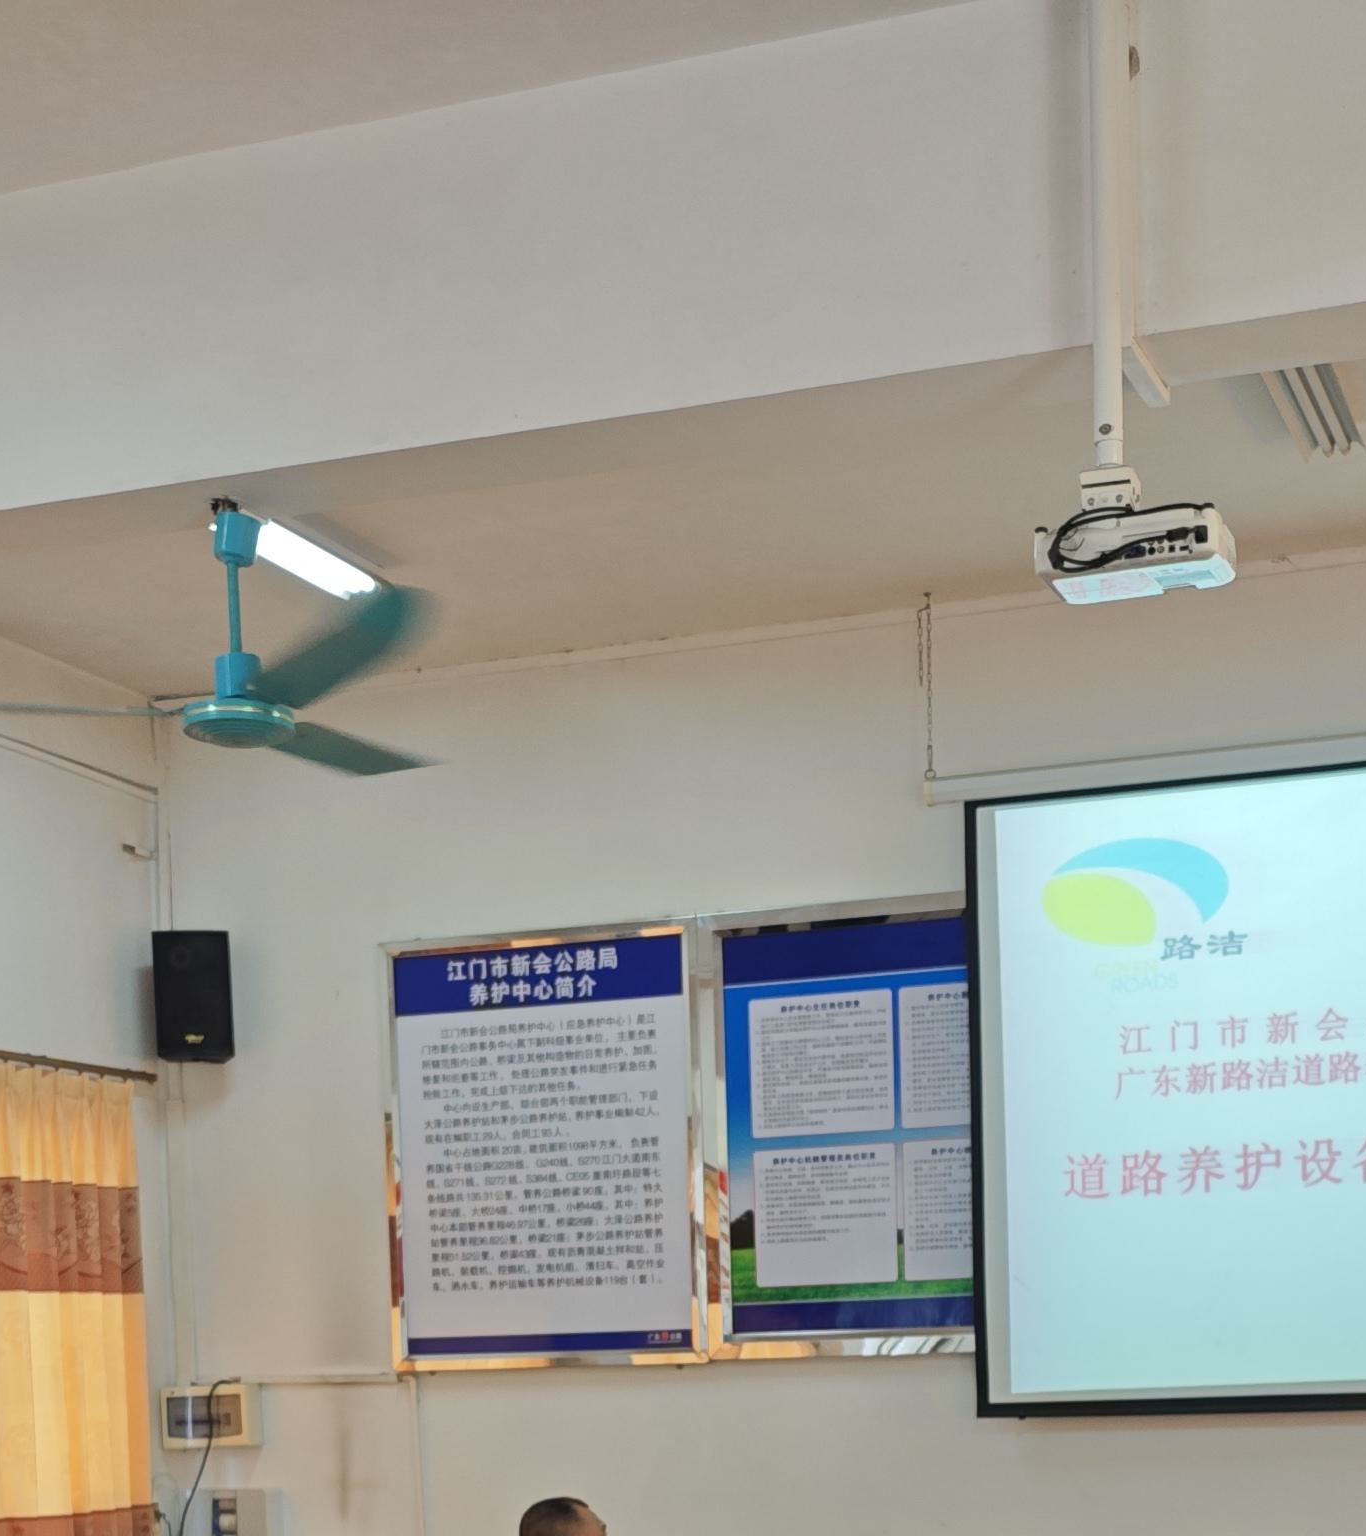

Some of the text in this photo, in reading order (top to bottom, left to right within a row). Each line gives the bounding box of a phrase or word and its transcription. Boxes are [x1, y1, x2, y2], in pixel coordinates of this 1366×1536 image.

[1160, 930, 1249, 961] 路洁
[446, 946, 618, 982] 江门市新会公路局
[469, 974, 598, 1006] 养护中心简介
